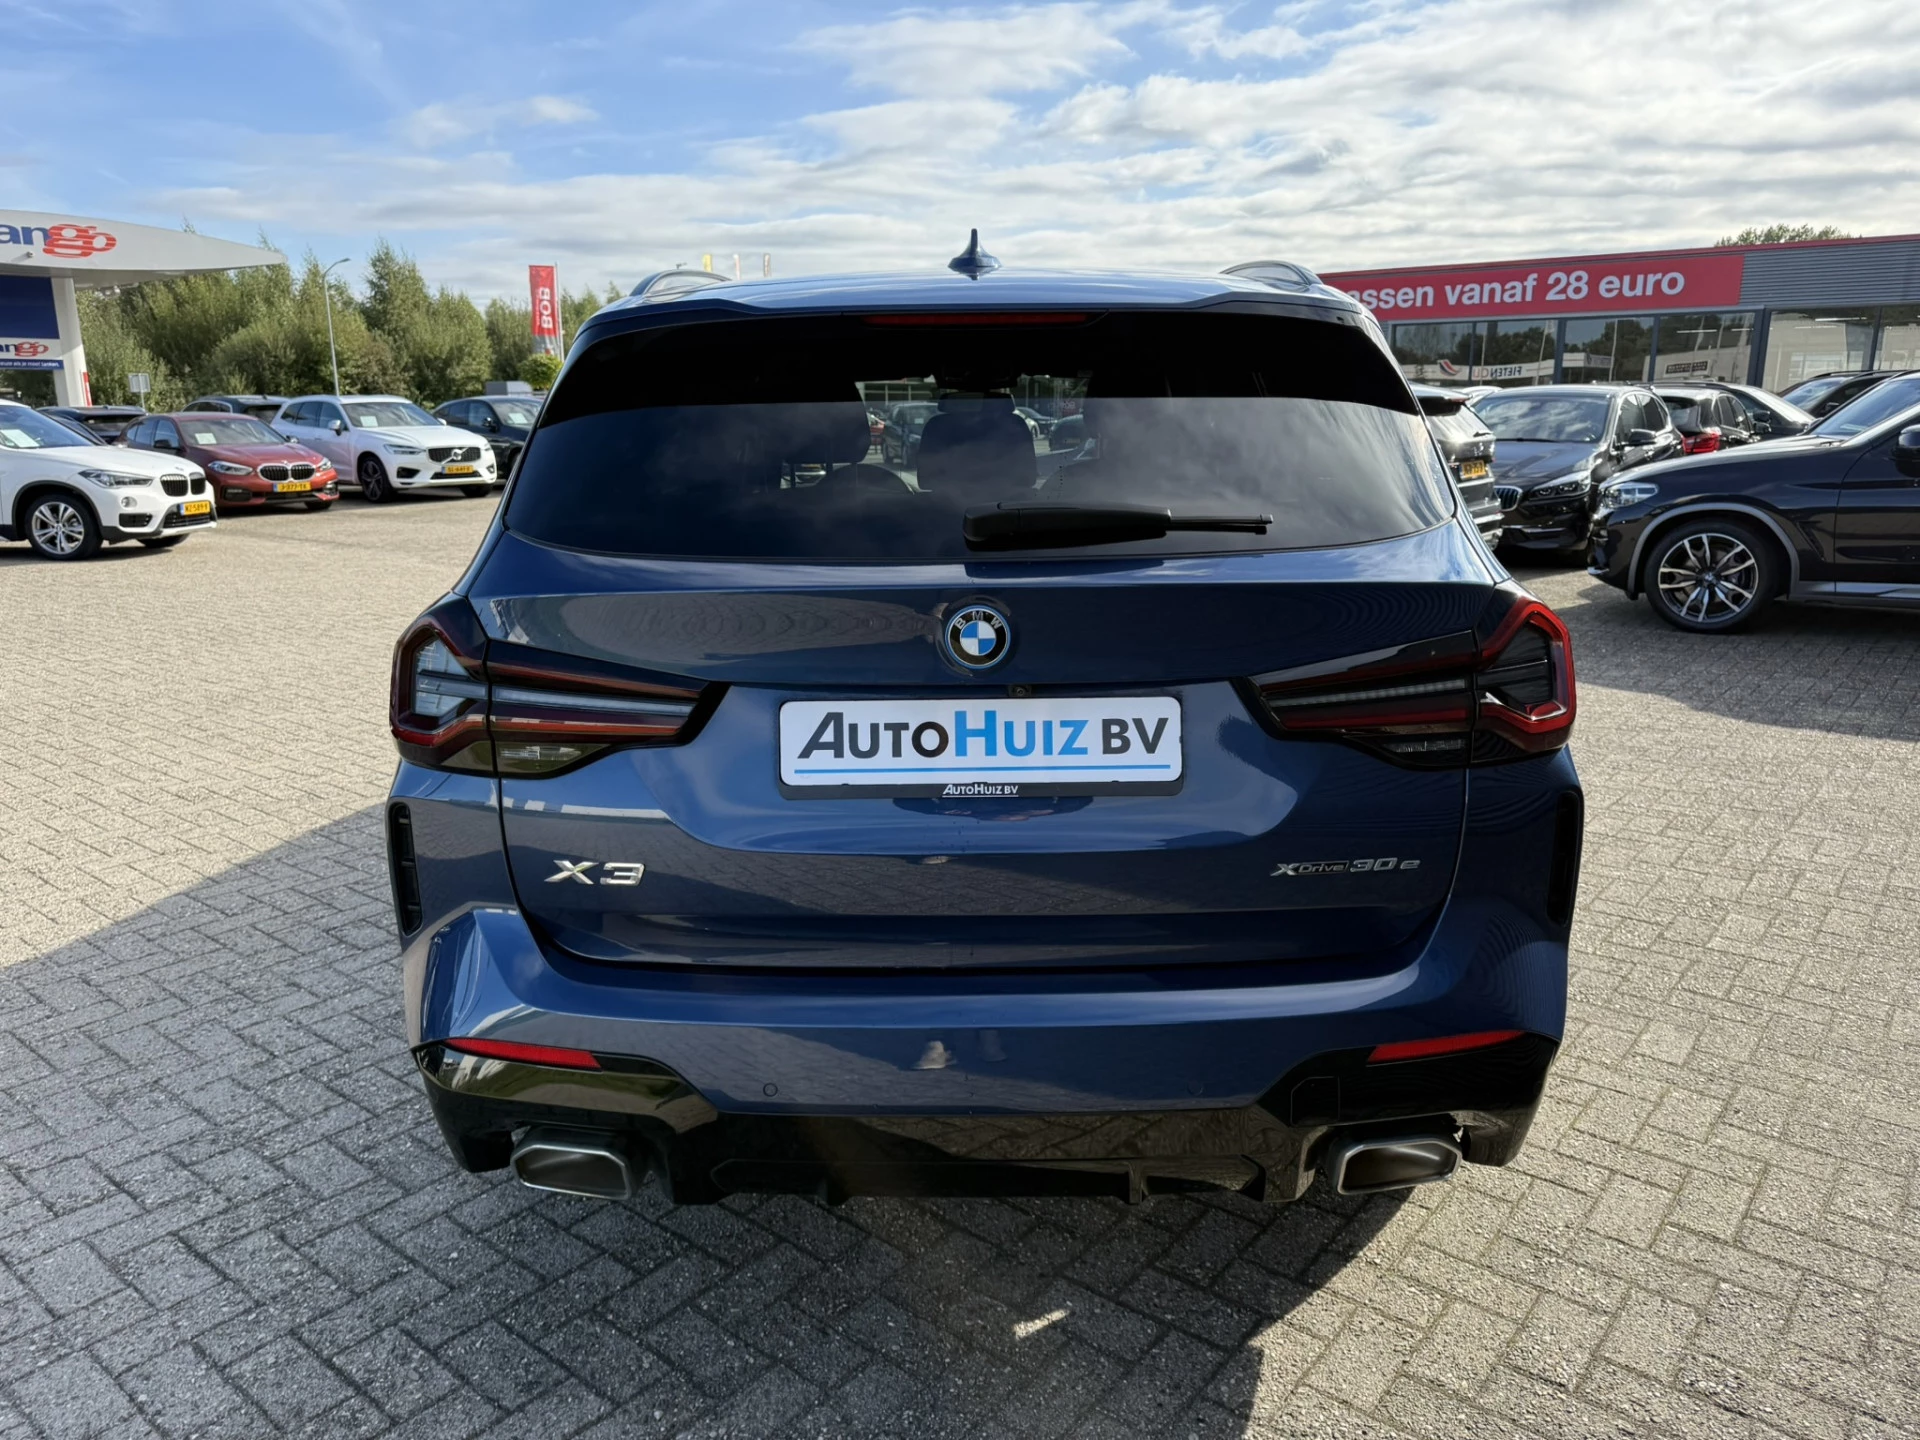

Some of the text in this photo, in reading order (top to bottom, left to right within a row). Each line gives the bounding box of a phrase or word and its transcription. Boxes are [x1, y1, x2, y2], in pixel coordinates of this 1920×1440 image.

[1444, 273, 1538, 306] vanaf
[1545, 270, 1589, 300] 28
[1598, 270, 1686, 298] euro
[540, 286, 553, 329] BOB
[954, 610, 1003, 630] BMW
[1101, 717, 1170, 755] BV
[1004, 785, 1019, 795] BV
[543, 859, 645, 886] X3
